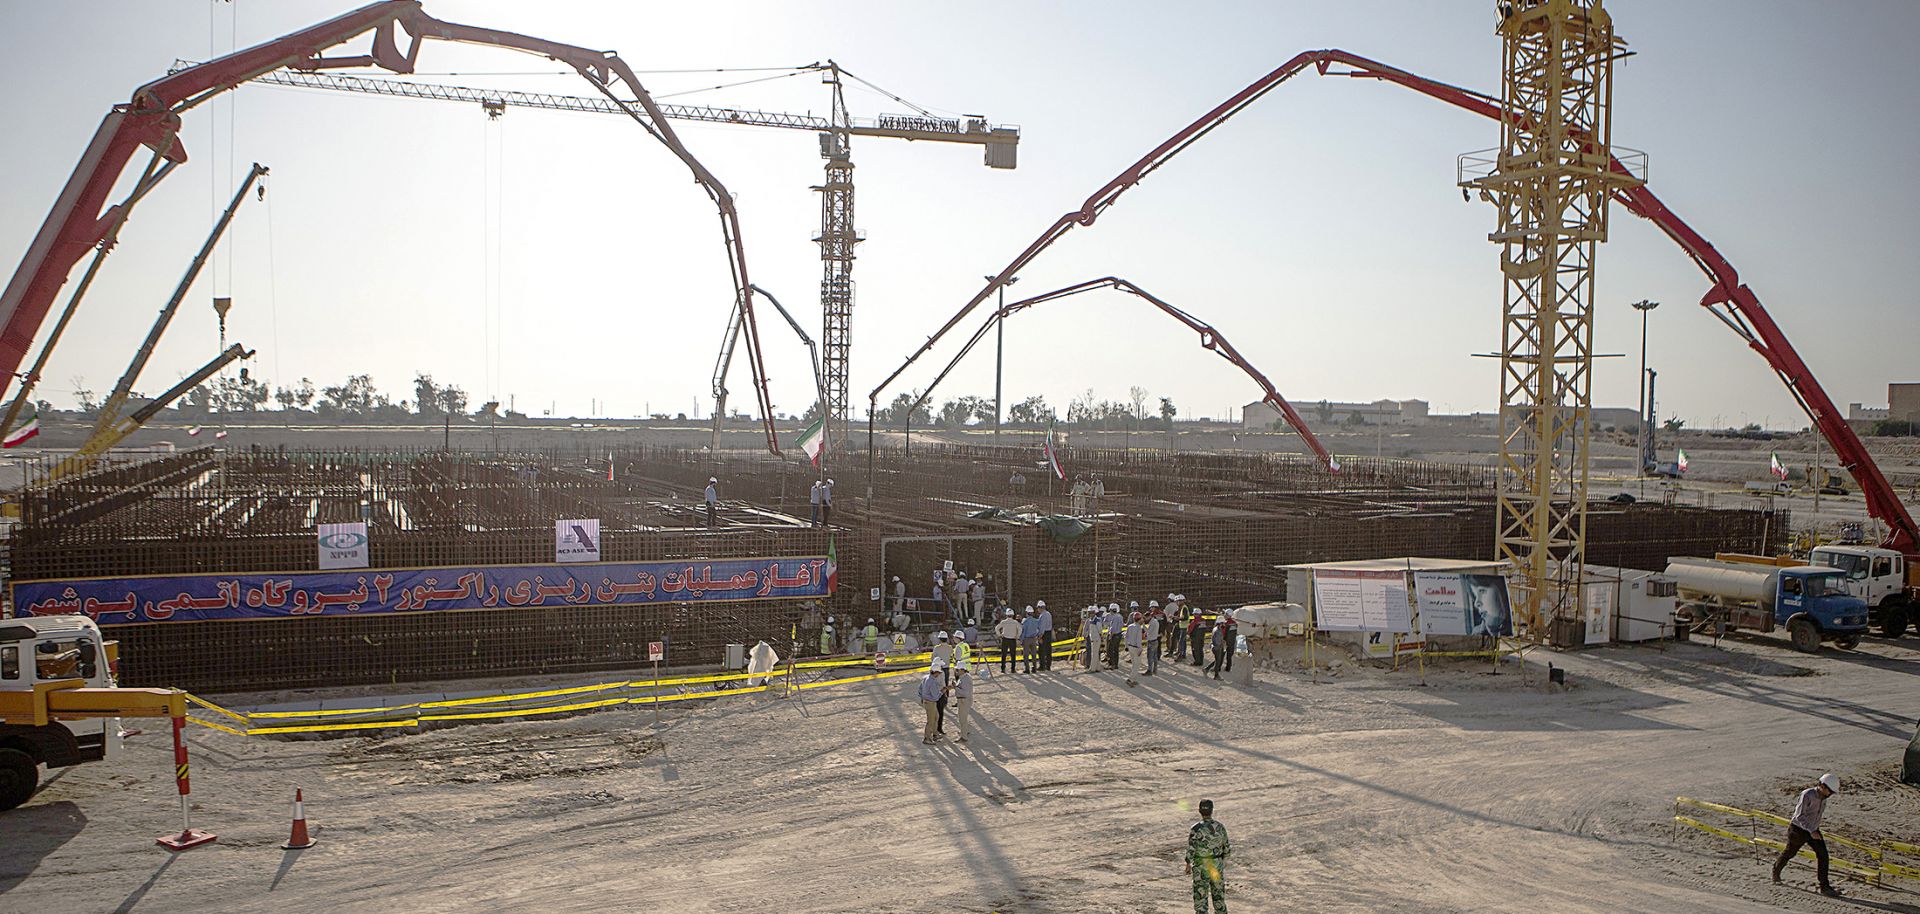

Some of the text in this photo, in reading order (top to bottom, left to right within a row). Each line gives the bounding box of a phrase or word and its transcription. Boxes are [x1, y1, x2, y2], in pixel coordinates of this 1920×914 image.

[246, 576, 369, 614] نیروگاه
[374, 573, 393, 606] ۲
[394, 571, 500, 610] راکتور
[505, 575, 592, 606] ریزی
[596, 571, 657, 602] بتن
[662, 564, 758, 597] عملیات
[757, 560, 825, 596] آغاز
[144, 580, 240, 619] اتمی
